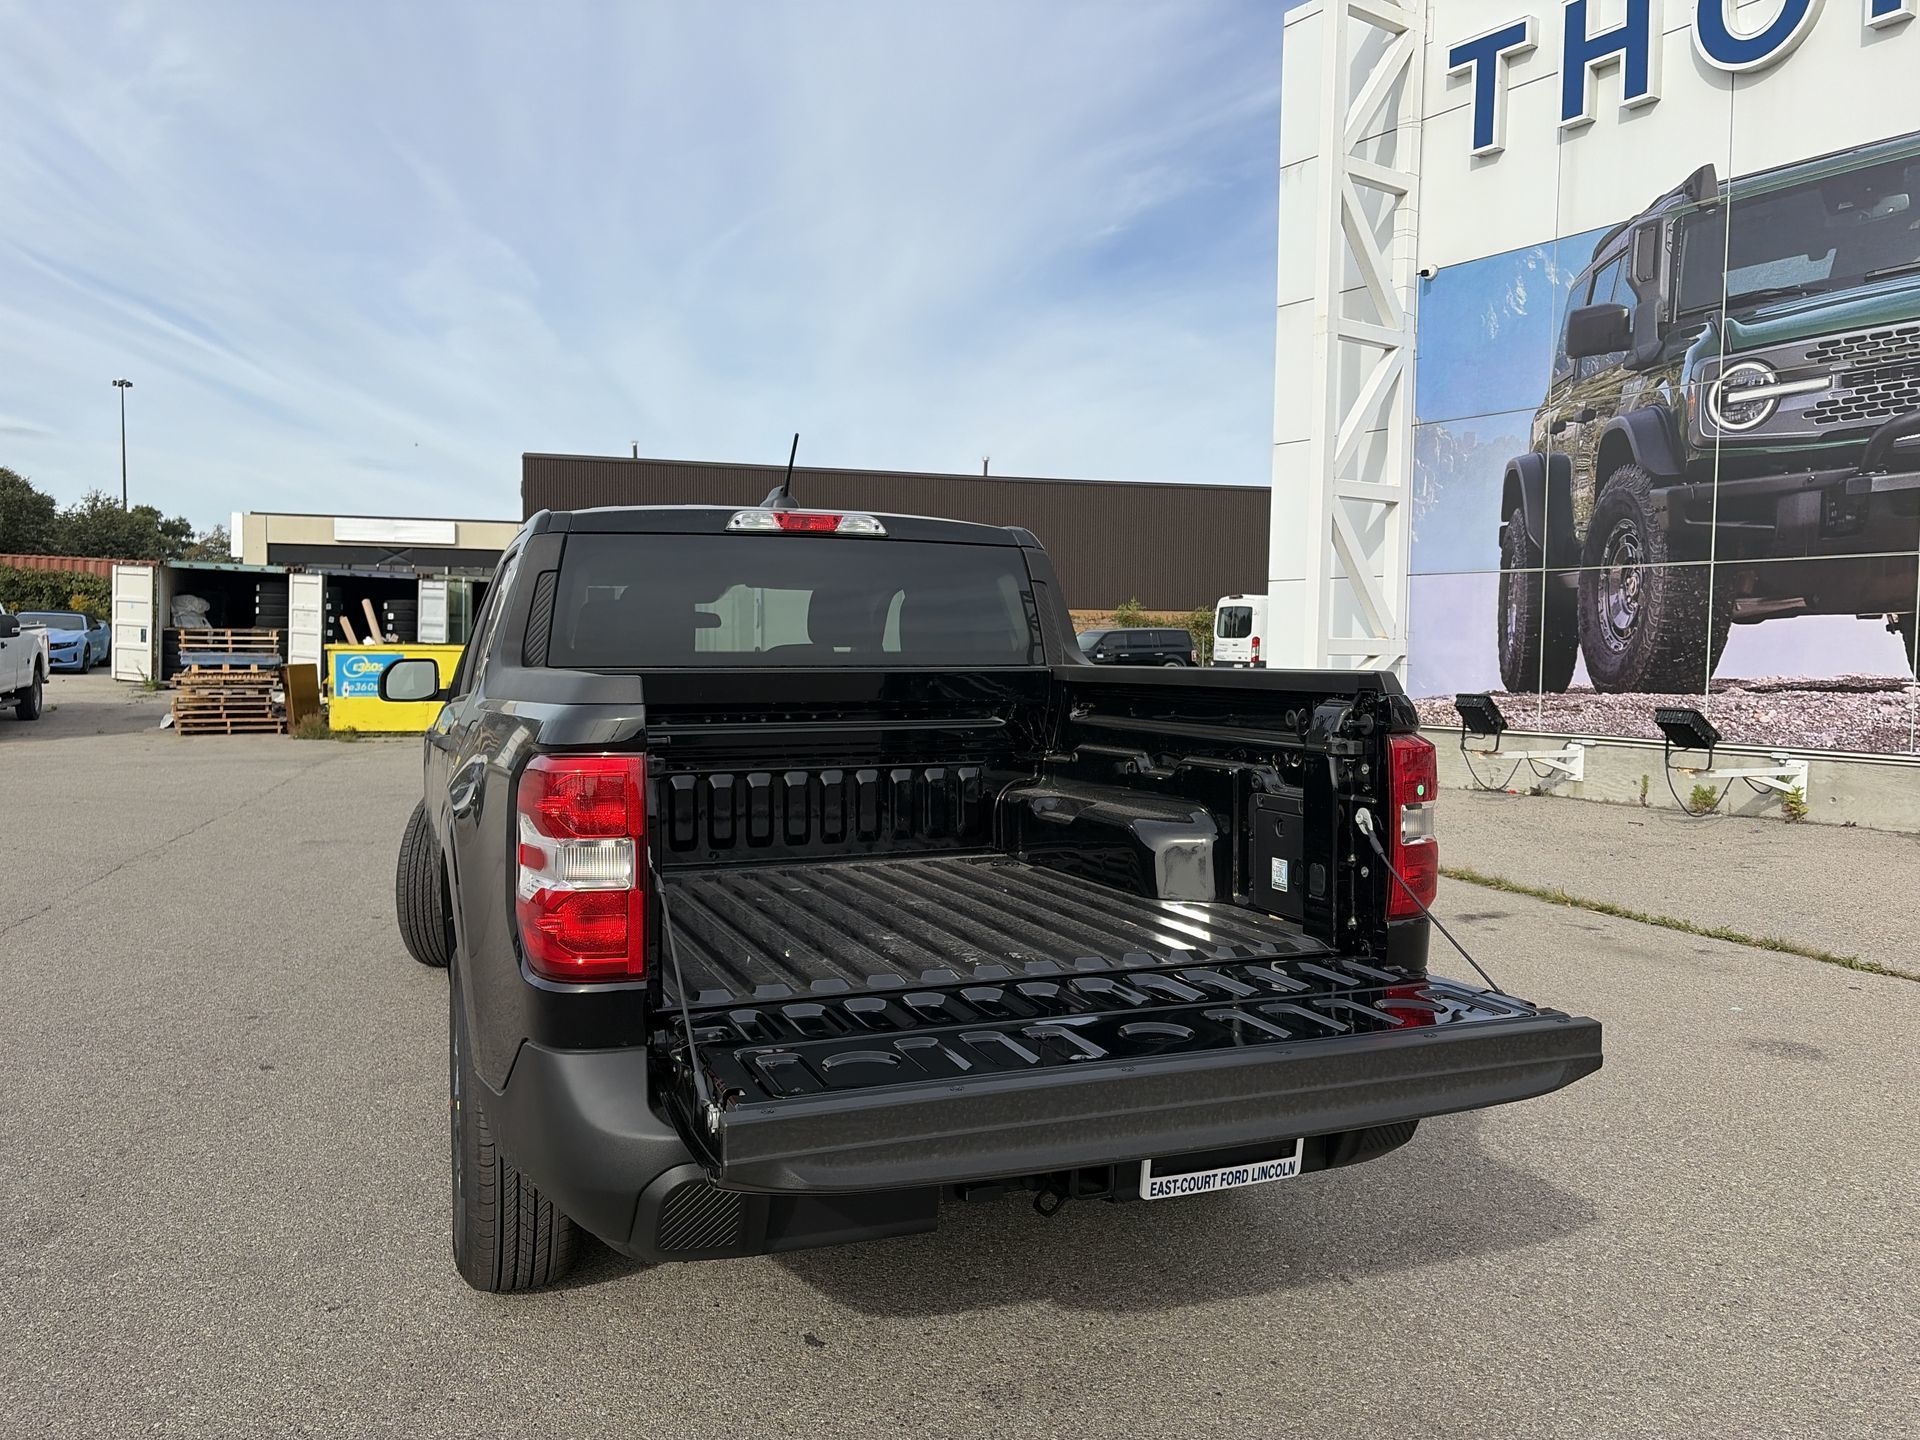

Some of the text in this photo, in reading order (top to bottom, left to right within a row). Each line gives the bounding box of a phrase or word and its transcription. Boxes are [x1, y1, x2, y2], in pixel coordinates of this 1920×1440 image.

[1447, 0, 1916, 157] THO
[1150, 1160, 1296, 1197] EAST-COURT FORD LINCOLN
